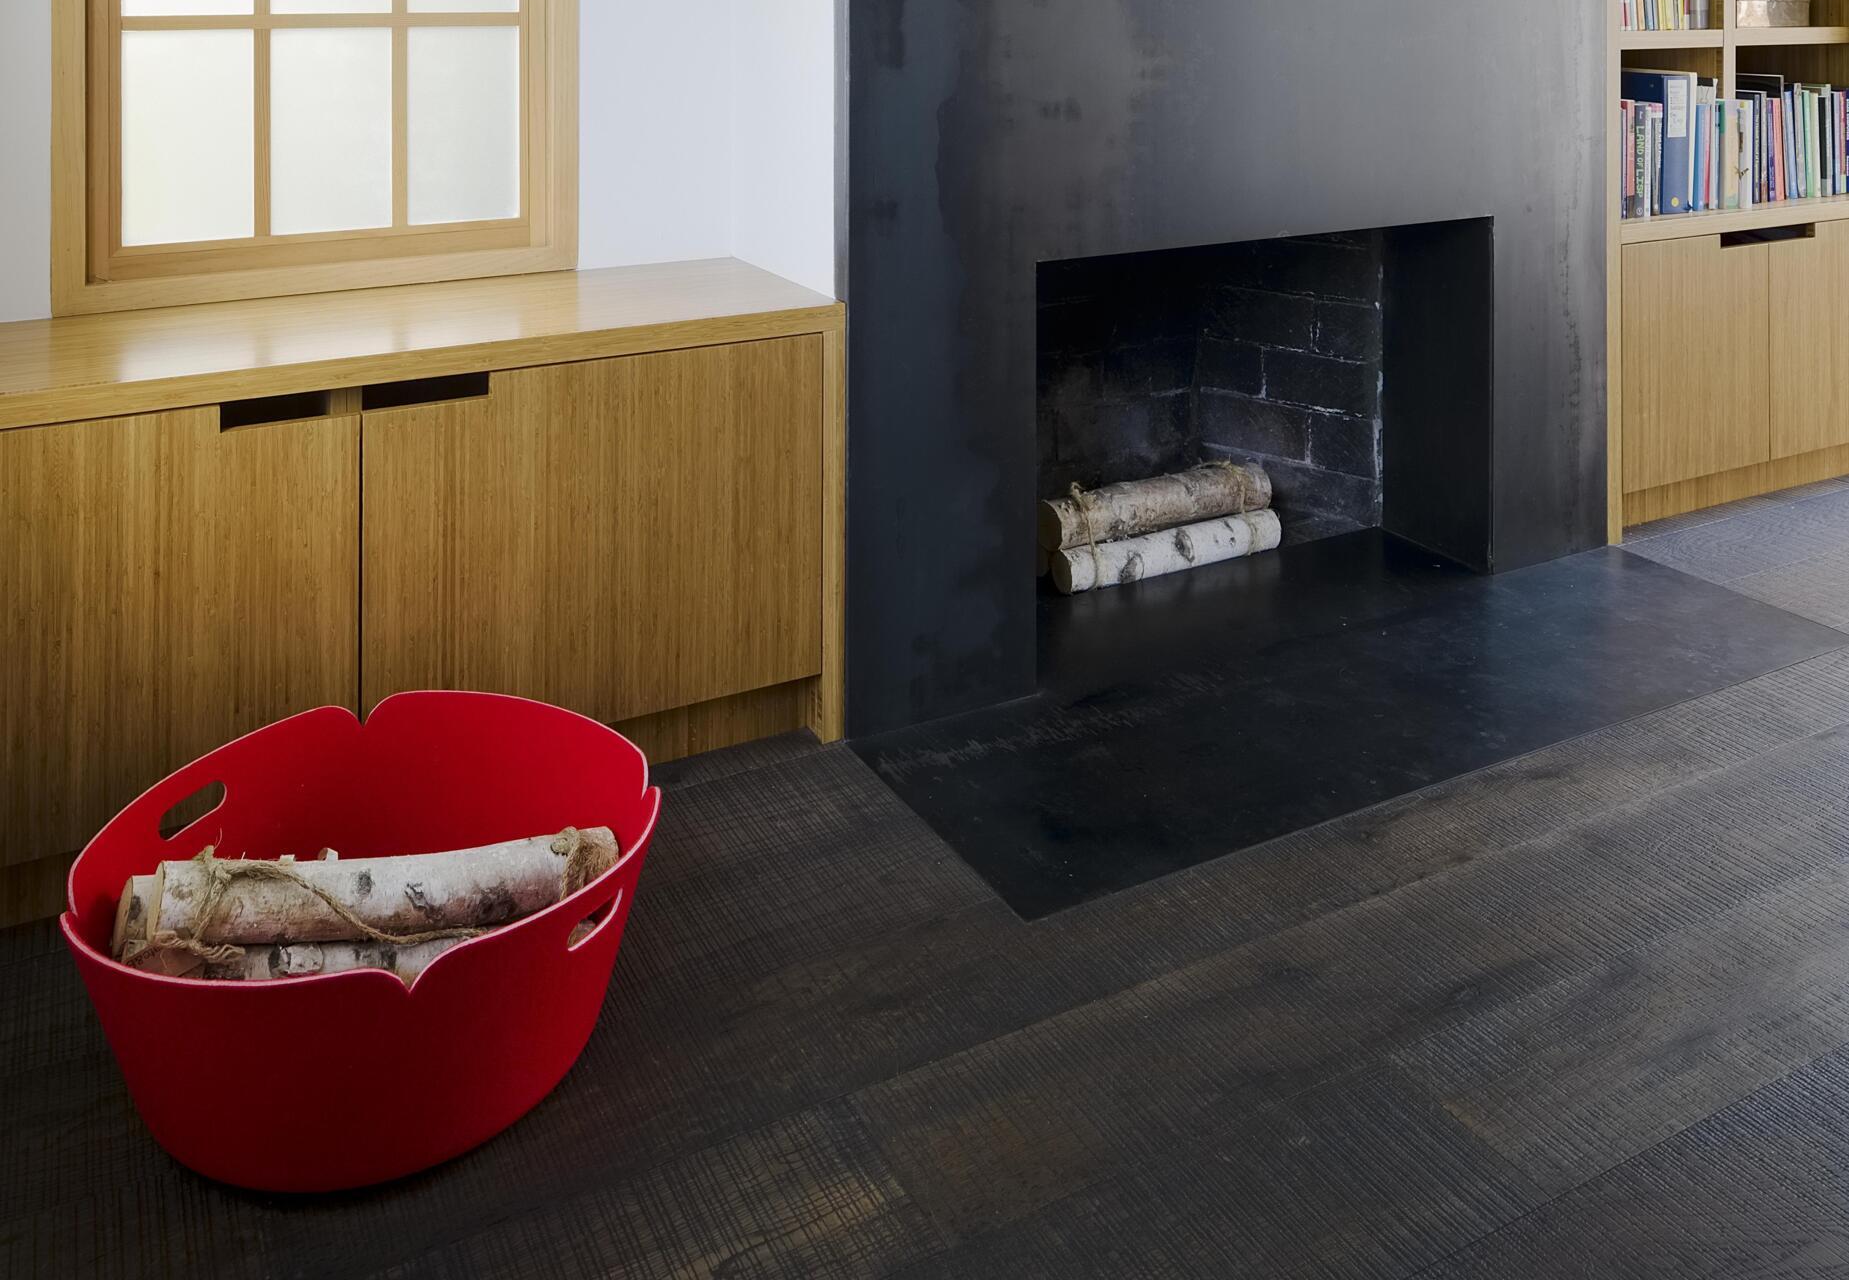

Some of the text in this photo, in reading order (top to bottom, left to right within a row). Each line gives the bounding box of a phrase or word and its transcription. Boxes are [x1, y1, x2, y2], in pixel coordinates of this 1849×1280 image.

[1636, 125, 1645, 198] LAND OF LISP
